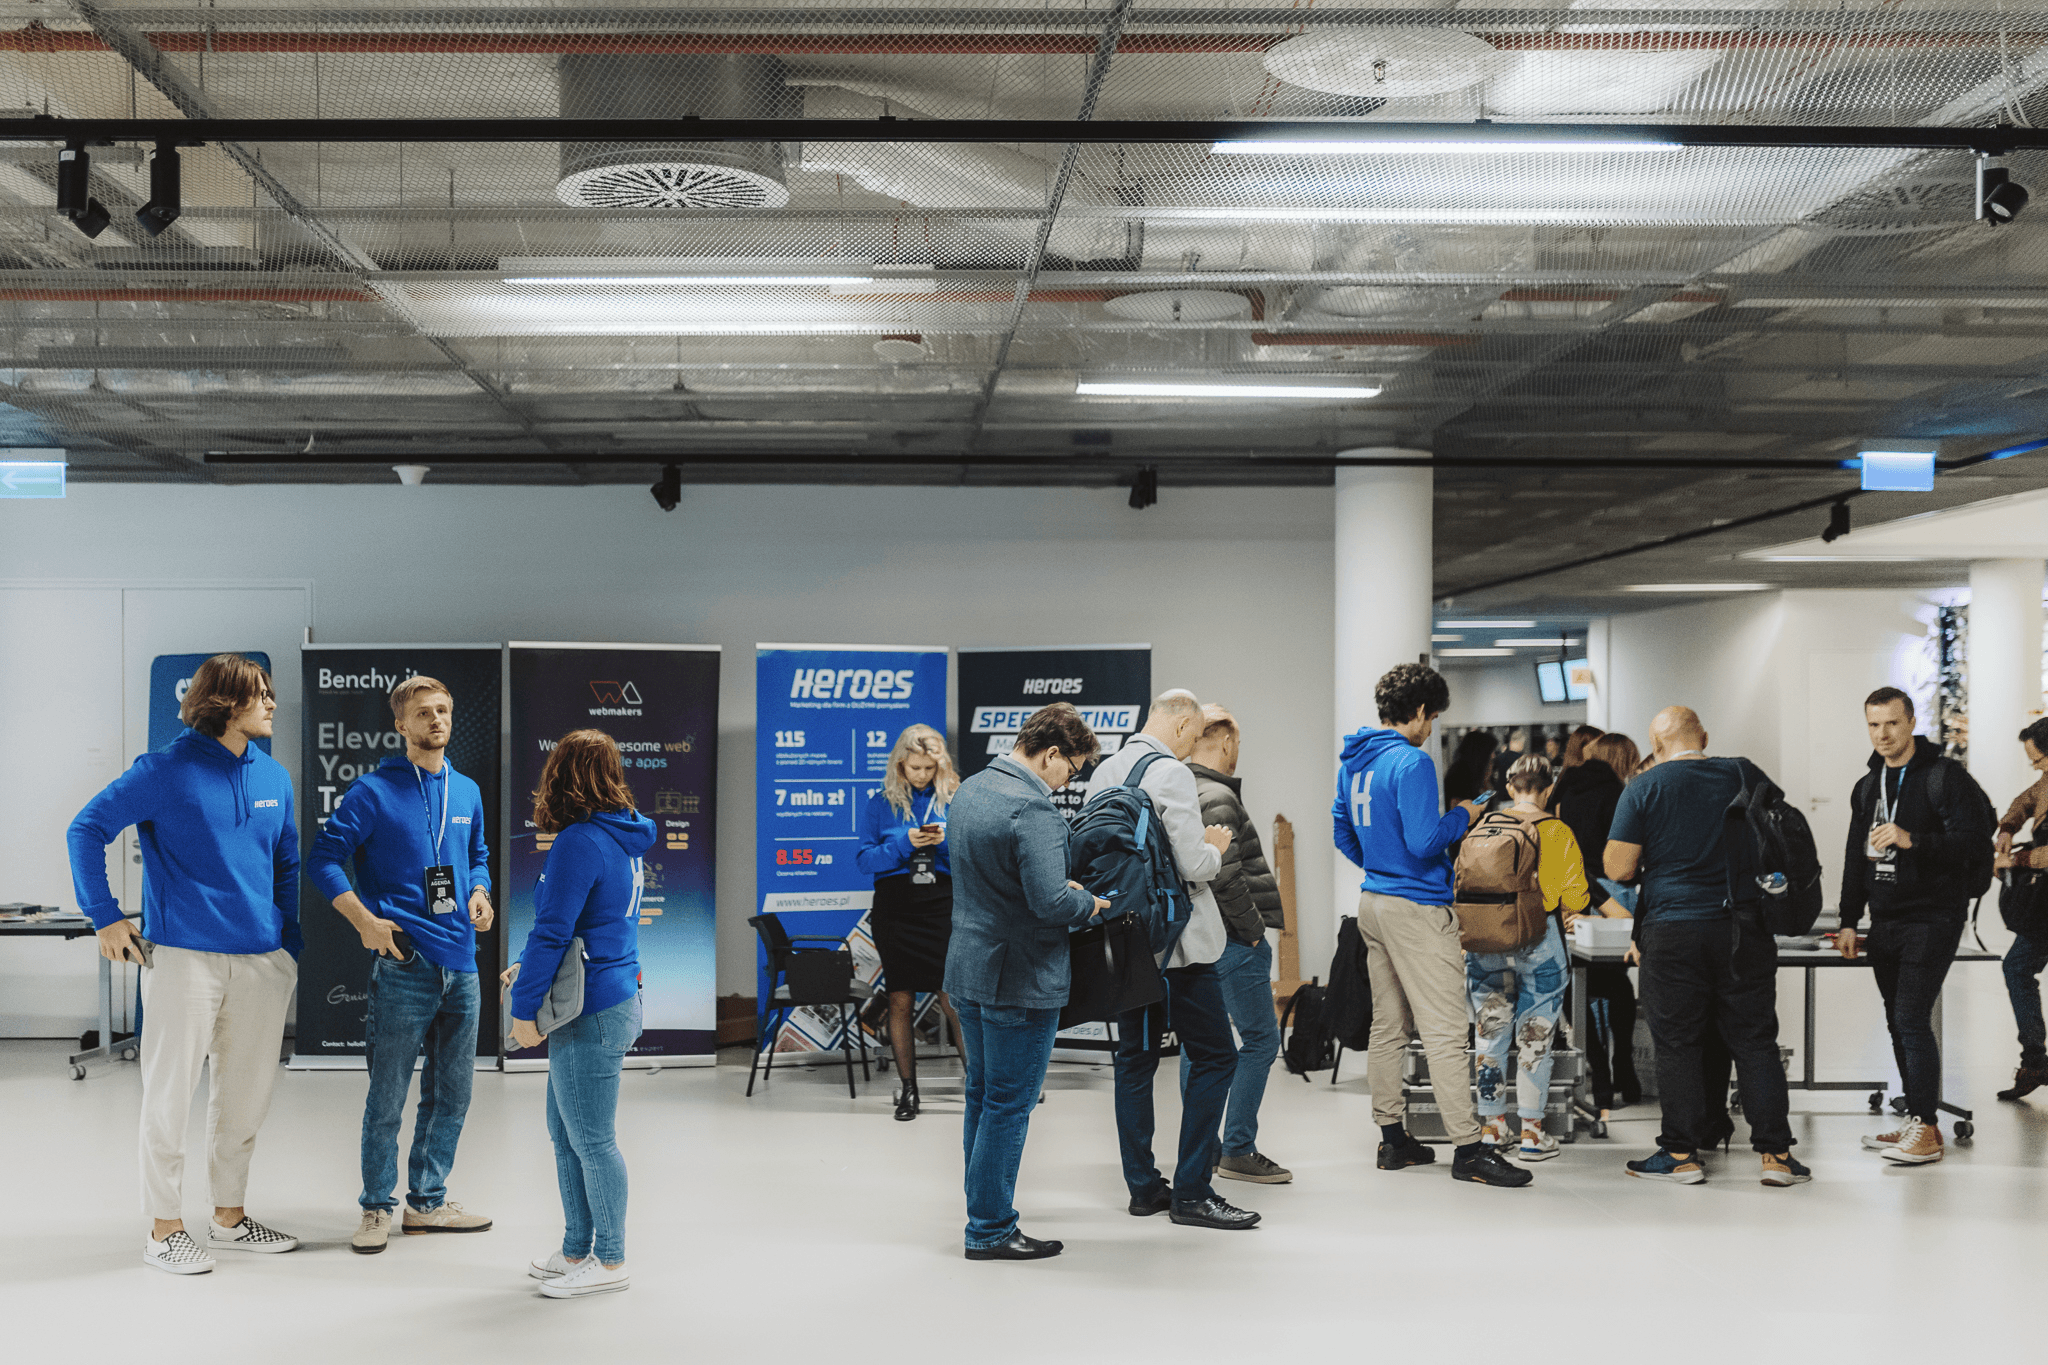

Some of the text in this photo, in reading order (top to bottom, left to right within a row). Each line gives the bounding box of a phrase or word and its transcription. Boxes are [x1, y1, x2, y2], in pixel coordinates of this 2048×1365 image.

[319, 667, 397, 694] Benchy
[589, 707, 642, 716] webmakers
[979, 711, 1129, 728] SPEE TING
[319, 722, 407, 749] Eleva
[775, 731, 806, 748] 115
[866, 731, 888, 748] 12
[539, 739, 558, 751] We
[664, 739, 691, 752] web
[636, 758, 667, 769] apps
[775, 789, 787, 806] 7
[790, 789, 824, 806] mln
[827, 789, 846, 806] zł
[1068, 794, 1081, 804] to
[1350, 770, 1375, 827] H
[665, 820, 690, 829] Design
[776, 849, 813, 866] 8.55
[430, 879, 451, 887] AGENDA
[776, 896, 851, 908] www.heroes.pl
